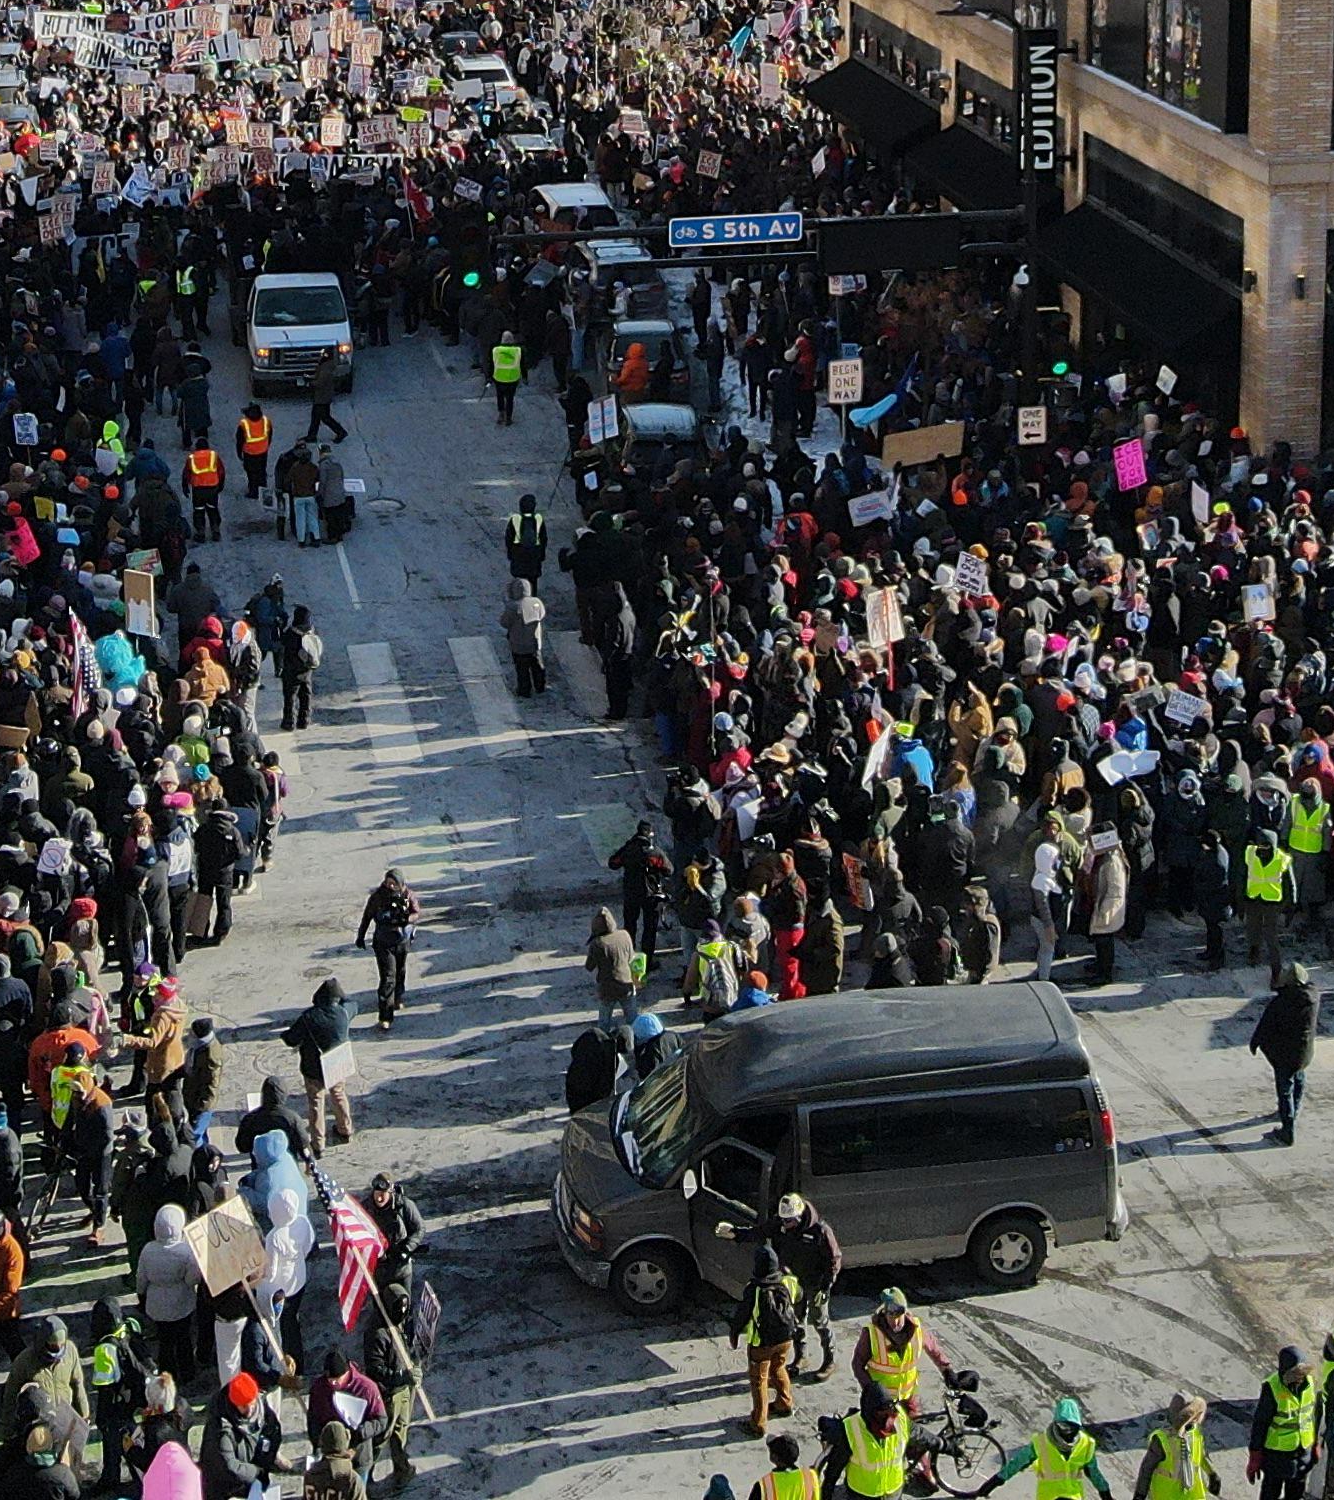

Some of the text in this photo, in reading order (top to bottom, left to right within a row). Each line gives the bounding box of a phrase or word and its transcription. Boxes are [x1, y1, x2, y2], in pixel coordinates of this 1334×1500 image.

[145, 11, 177, 31] FOR
[1020, 45, 1056, 170] EDITION
[702, 219, 796, 239] S 5th Av
[832, 363, 859, 375] BEGIN
[835, 376, 857, 387] ONE
[834, 389, 857, 400] WAY
[1022, 409, 1042, 419] ONE
[1021, 420, 1042, 429] WAY
[1115, 441, 1139, 460] ICE
[1117, 453, 1141, 470] OUT
[188, 1211, 245, 1258] FUCK
